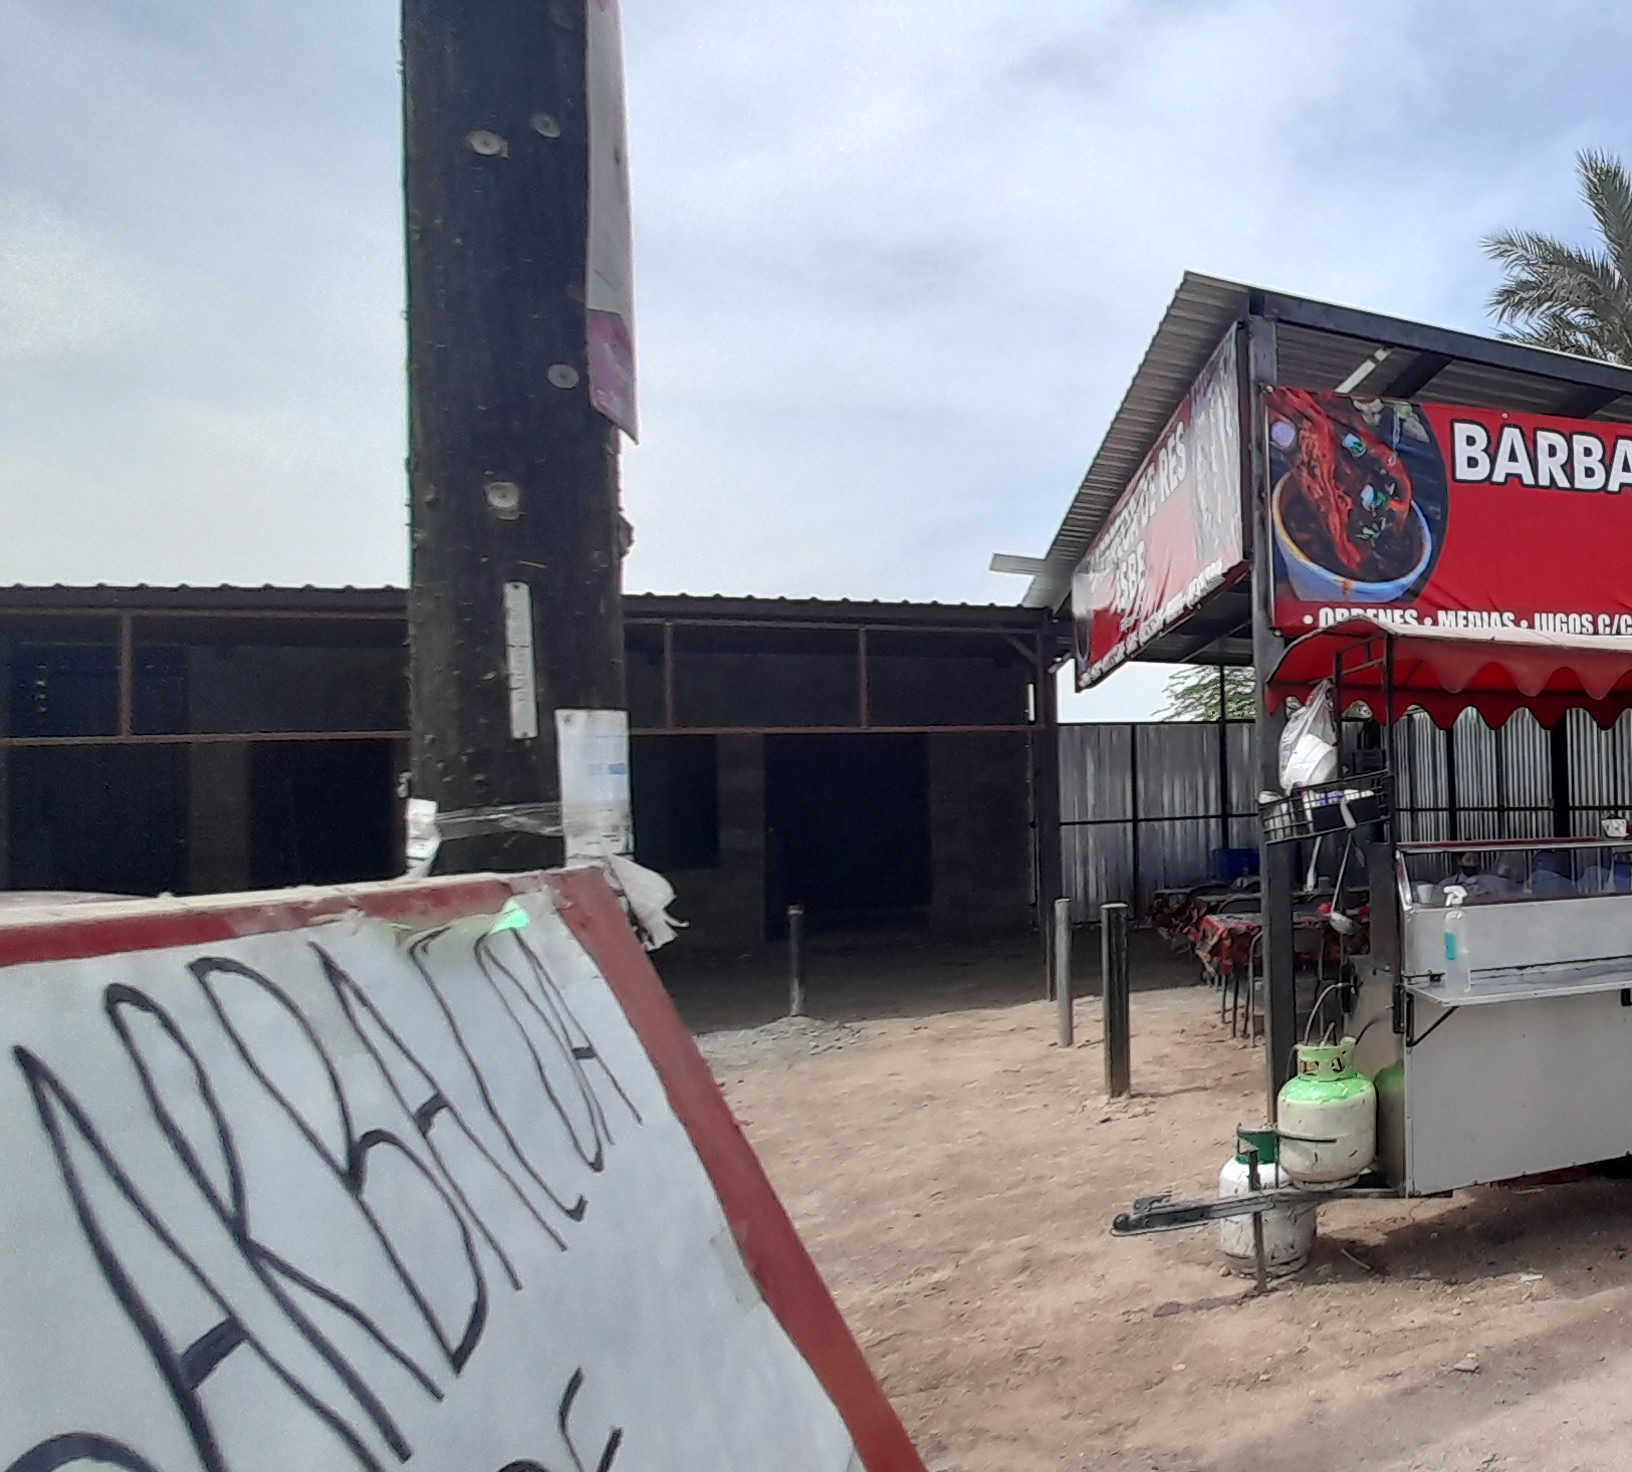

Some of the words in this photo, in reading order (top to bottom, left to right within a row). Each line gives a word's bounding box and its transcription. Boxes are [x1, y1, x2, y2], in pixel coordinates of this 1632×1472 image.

[1158, 420, 1187, 503] RES
[1437, 610, 1515, 629] MEDIAS
[0, 925, 643, 1472] ARBACOA
